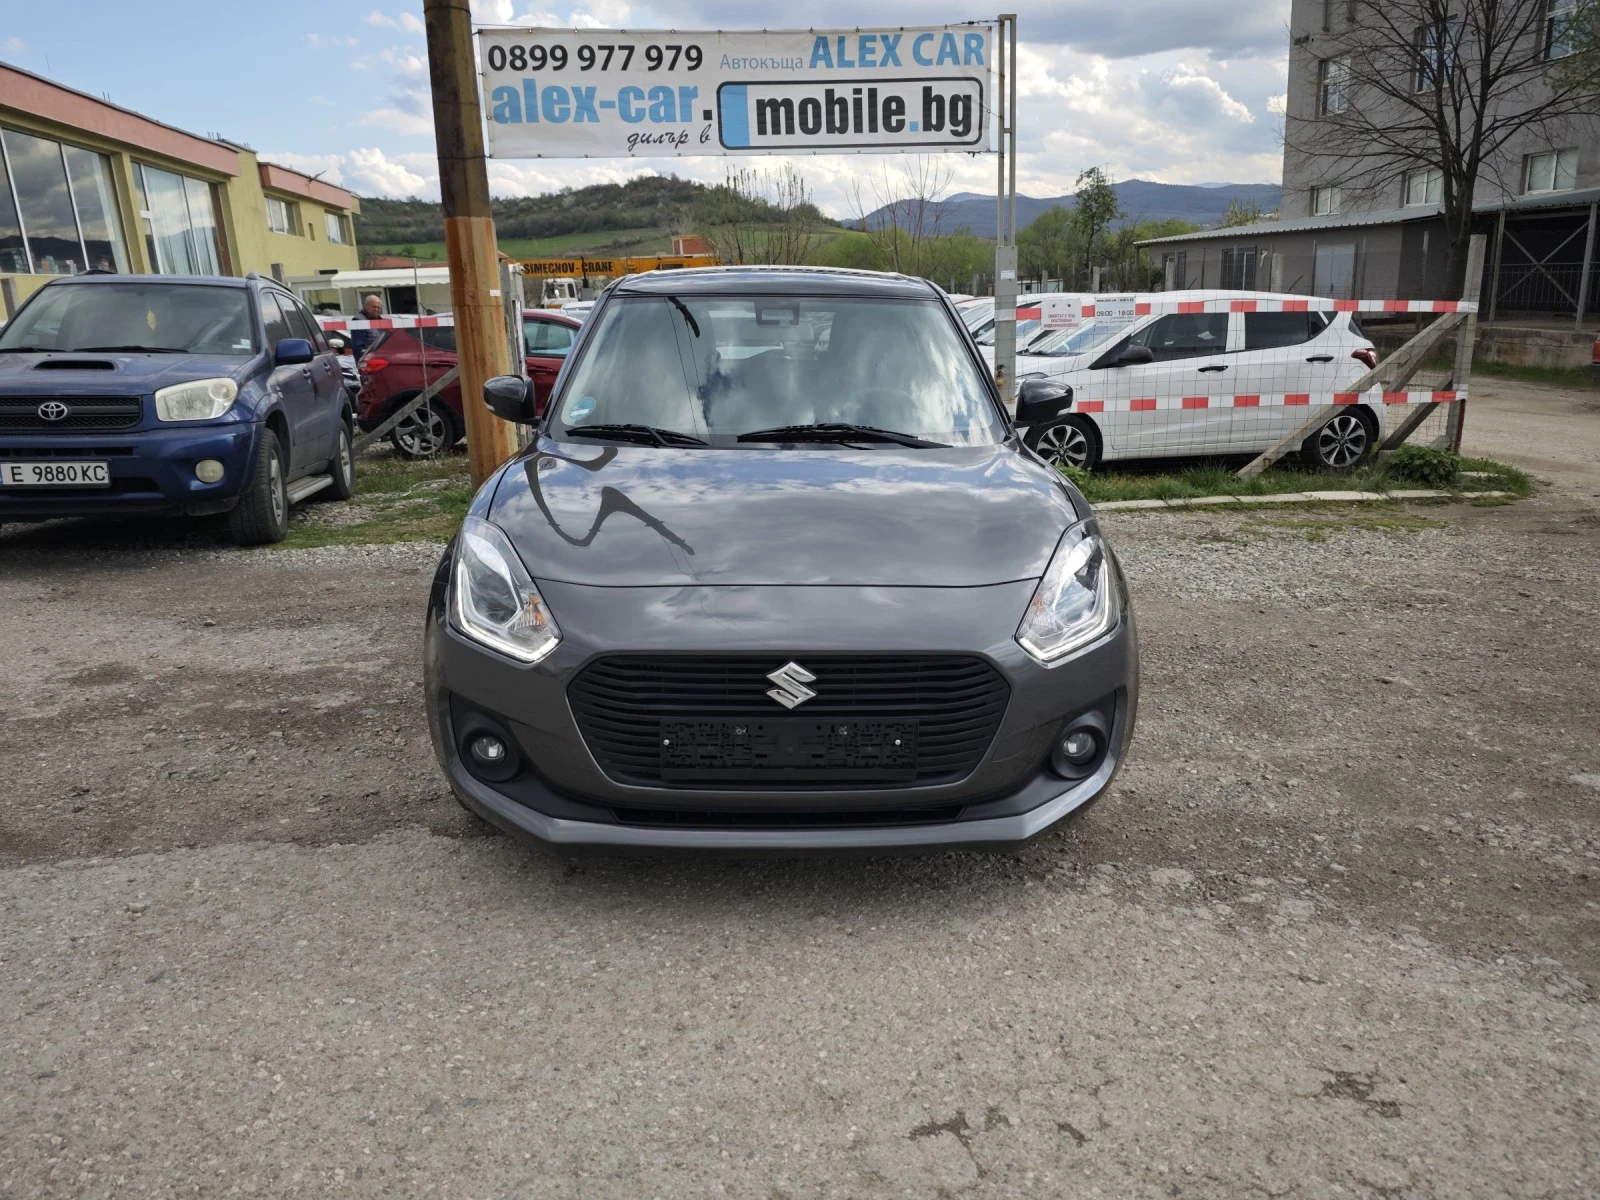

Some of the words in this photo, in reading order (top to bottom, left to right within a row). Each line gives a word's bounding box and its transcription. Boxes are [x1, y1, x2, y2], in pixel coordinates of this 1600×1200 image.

[488, 45, 568, 71] 0899
[577, 45, 635, 71] 977
[645, 44, 703, 71] 979
[720, 53, 803, 71] Автокъща
[808, 35, 903, 69] ALEX
[912, 33, 985, 66] CAR
[756, 86, 972, 137] mobile.bg
[627, 129, 689, 151] дилър
[699, 124, 711, 144] в
[582, 261, 613, 272] CRANE
[10, 466, 24, 482] E
[32, 466, 77, 482] 9880
